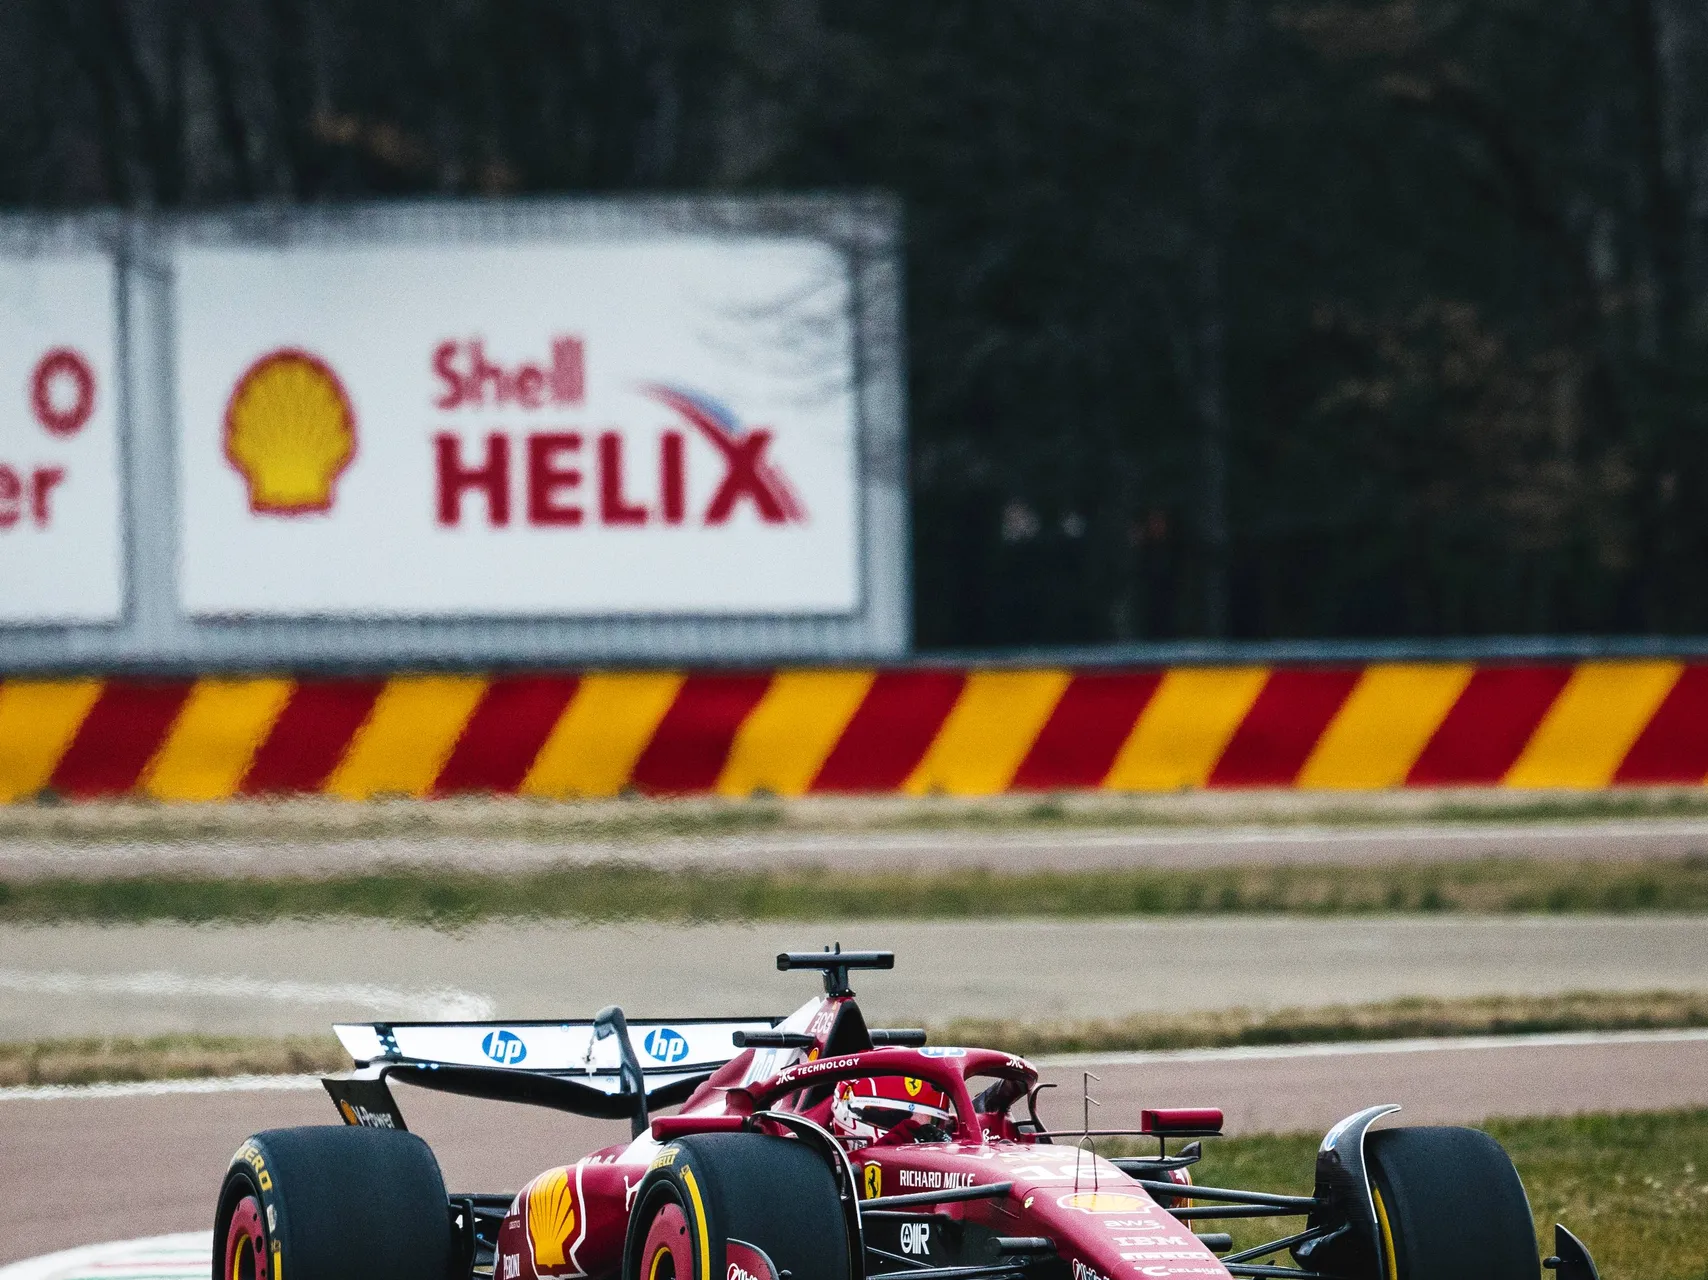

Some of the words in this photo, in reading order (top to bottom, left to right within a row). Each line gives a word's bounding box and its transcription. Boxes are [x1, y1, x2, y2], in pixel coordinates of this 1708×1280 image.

[432, 336, 585, 410] Shell
[434, 425, 800, 527] HELIX
[488, 1031, 521, 1064] hp
[651, 1028, 683, 1063] hp
[797, 1058, 860, 1075] TECHNOLOGY
[900, 1170, 941, 1188] RICHARD
[1010, 1164, 1122, 1181] 16
[1104, 1219, 1160, 1229] aws
[1112, 1236, 1188, 1246] IBM
